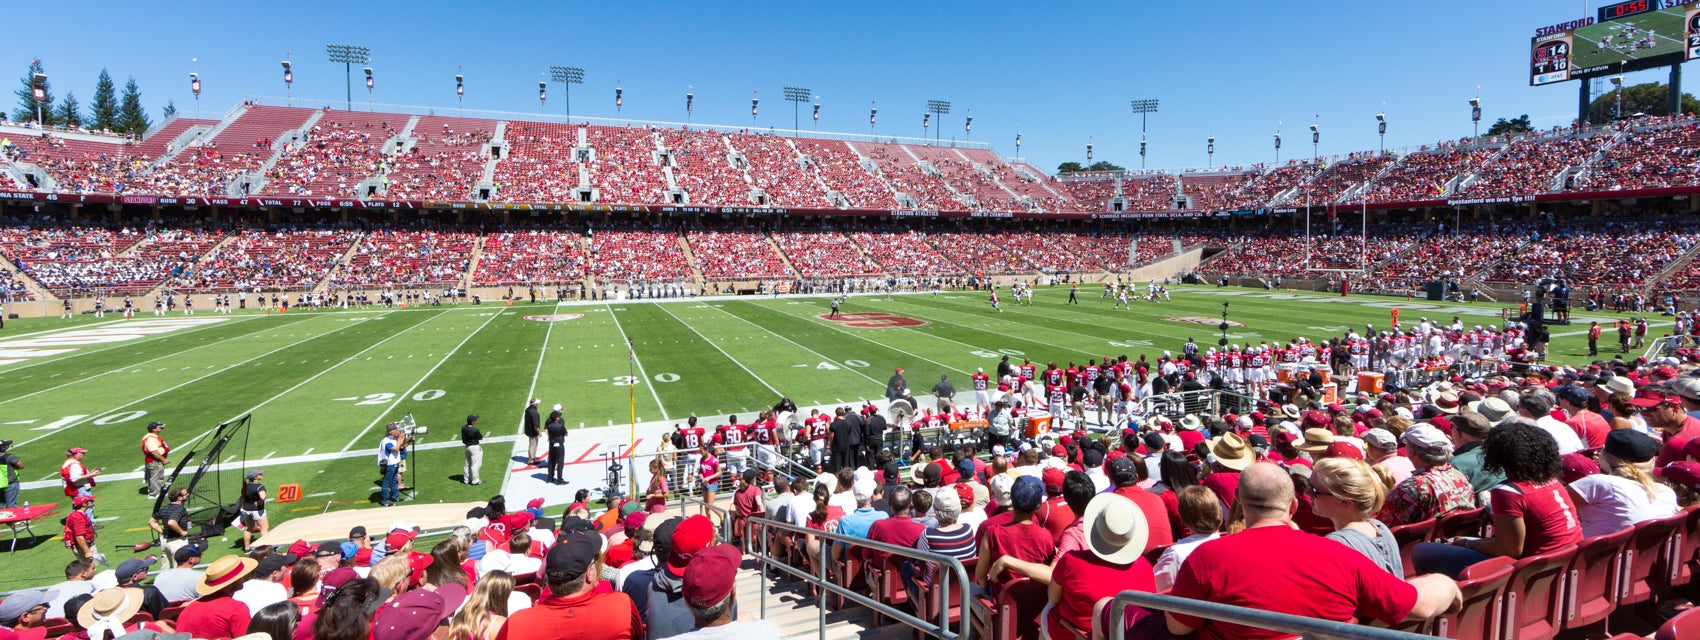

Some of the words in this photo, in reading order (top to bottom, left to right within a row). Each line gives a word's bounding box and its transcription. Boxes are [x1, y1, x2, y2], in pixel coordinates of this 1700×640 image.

[1615, 1, 1647, 16] 0:55
[1535, 17, 1595, 37] STANFORD
[1536, 33, 1566, 42] STANFORD
[1549, 44, 1566, 56] 14
[1553, 62, 1566, 70] 10
[354, 389, 446, 406] 20
[754, 428, 769, 442] 73
[812, 422, 826, 436] 75
[1038, 422, 1048, 434] G
[685, 434, 699, 449] 18
[280, 486, 297, 500] 20
